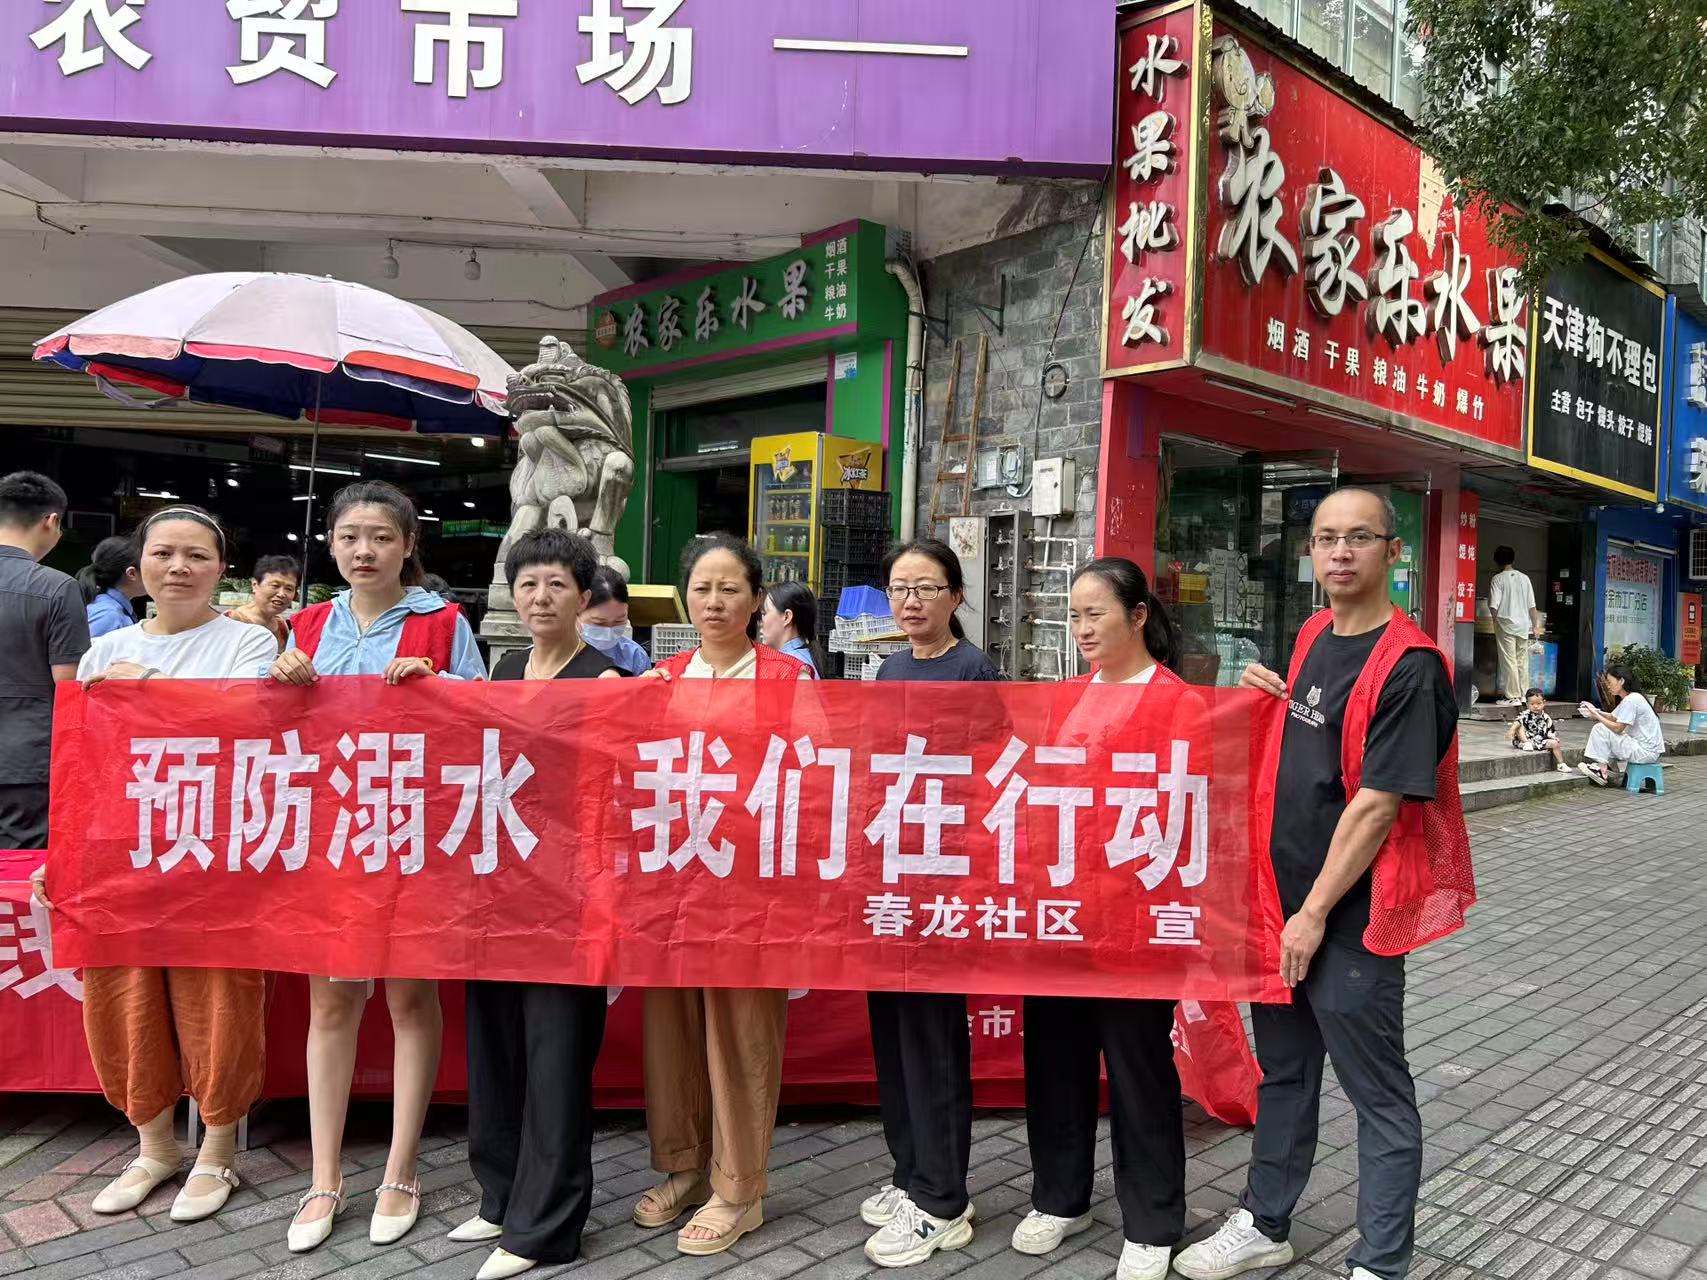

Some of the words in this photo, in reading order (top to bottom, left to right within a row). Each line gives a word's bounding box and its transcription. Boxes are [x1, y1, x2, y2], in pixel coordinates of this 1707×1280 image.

[1119, 33, 1190, 348] 水果批发
[824, 258, 848, 280] 干果
[825, 237, 848, 258] 烟酒
[1217, 127, 1527, 383] 农家乐水果
[623, 259, 809, 358] 农家乐水果
[823, 302, 847, 321] 牛奶
[824, 281, 847, 302] 粮油
[1266, 317, 1311, 361] 烟酒
[1324, 339, 1361, 377] 干果
[1372, 355, 1408, 395] 粮油
[1415, 372, 1446, 408] 牛奶
[1543, 295, 1657, 394] 天津狗不理包
[1551, 388, 1572, 415] 主营
[1575, 396, 1595, 423] 包子
[1617, 413, 1635, 439] 饺子
[1457, 582, 1475, 599] 饺子
[1605, 588, 1648, 611] 余市工厂分店
[125, 727, 541, 876] 预防溺水
[630, 730, 1209, 892] 我们在行动
[863, 892, 1084, 942] 春龙社区
[1148, 901, 1201, 946] 宣
